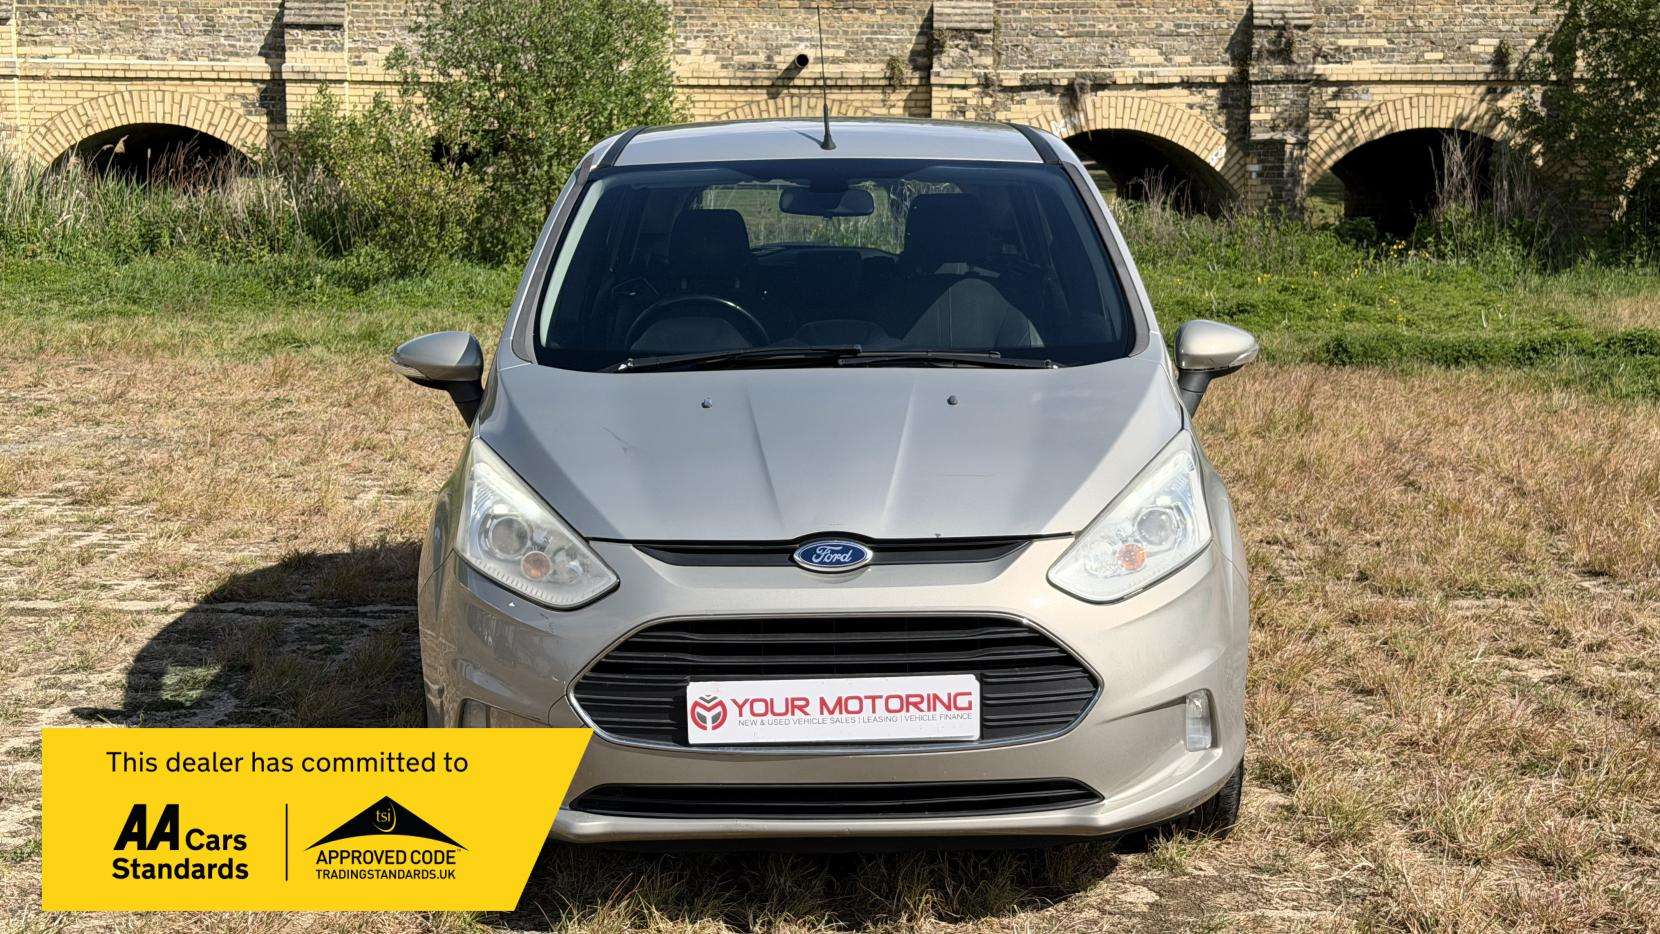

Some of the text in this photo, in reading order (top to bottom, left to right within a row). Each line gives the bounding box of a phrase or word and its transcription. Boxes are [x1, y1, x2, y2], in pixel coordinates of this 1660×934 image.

[812, 545, 853, 563] Ford
[730, 692, 972, 717] YOUR MOTORING
[738, 719, 758, 727] NEW
[767, 718, 791, 726] USED
[793, 717, 828, 725] VEHICLE
[829, 716, 856, 724] SALES
[862, 715, 898, 723] LEASING
[904, 714, 937, 722] VEHICLE
